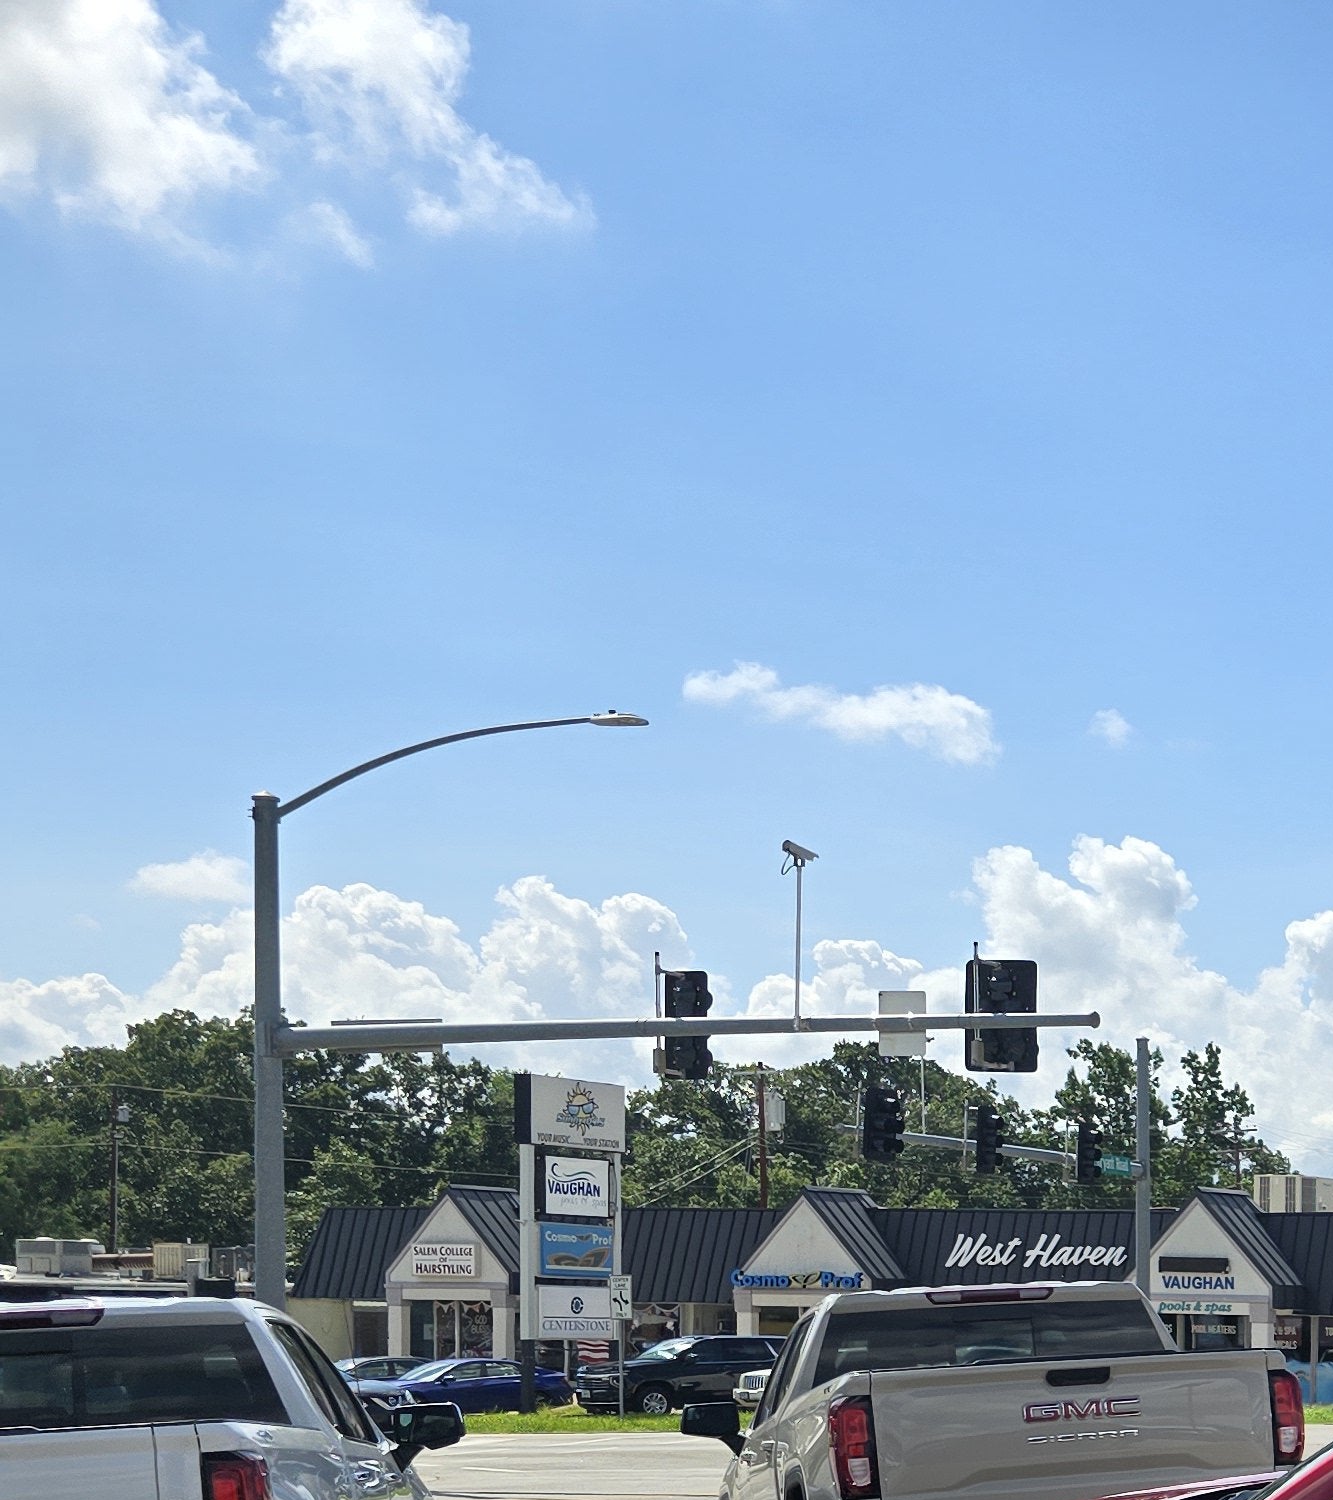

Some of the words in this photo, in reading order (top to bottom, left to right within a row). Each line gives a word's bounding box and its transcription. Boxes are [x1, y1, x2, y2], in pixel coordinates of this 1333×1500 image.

[548, 1179, 600, 1197] VAUGHAN
[545, 1230, 577, 1243] Cosmo
[592, 1233, 612, 1245] Prof
[414, 1246, 438, 1256] SALEM
[440, 1246, 473, 1256] COLLEGE
[945, 1233, 1023, 1268] West
[1023, 1233, 1128, 1268] Haven
[415, 1263, 472, 1275] HAIRSTYLING
[730, 1269, 791, 1288] Cosmo
[820, 1271, 863, 1289] Prof
[1162, 1275, 1235, 1290] VAUGHAN
[1158, 1301, 1191, 1315] pools
[1204, 1302, 1233, 1315] spas
[542, 1320, 611, 1332] CENTERSTONE
[1023, 1396, 1141, 1423] GMC
[1027, 1429, 1139, 1444] SIERRA
